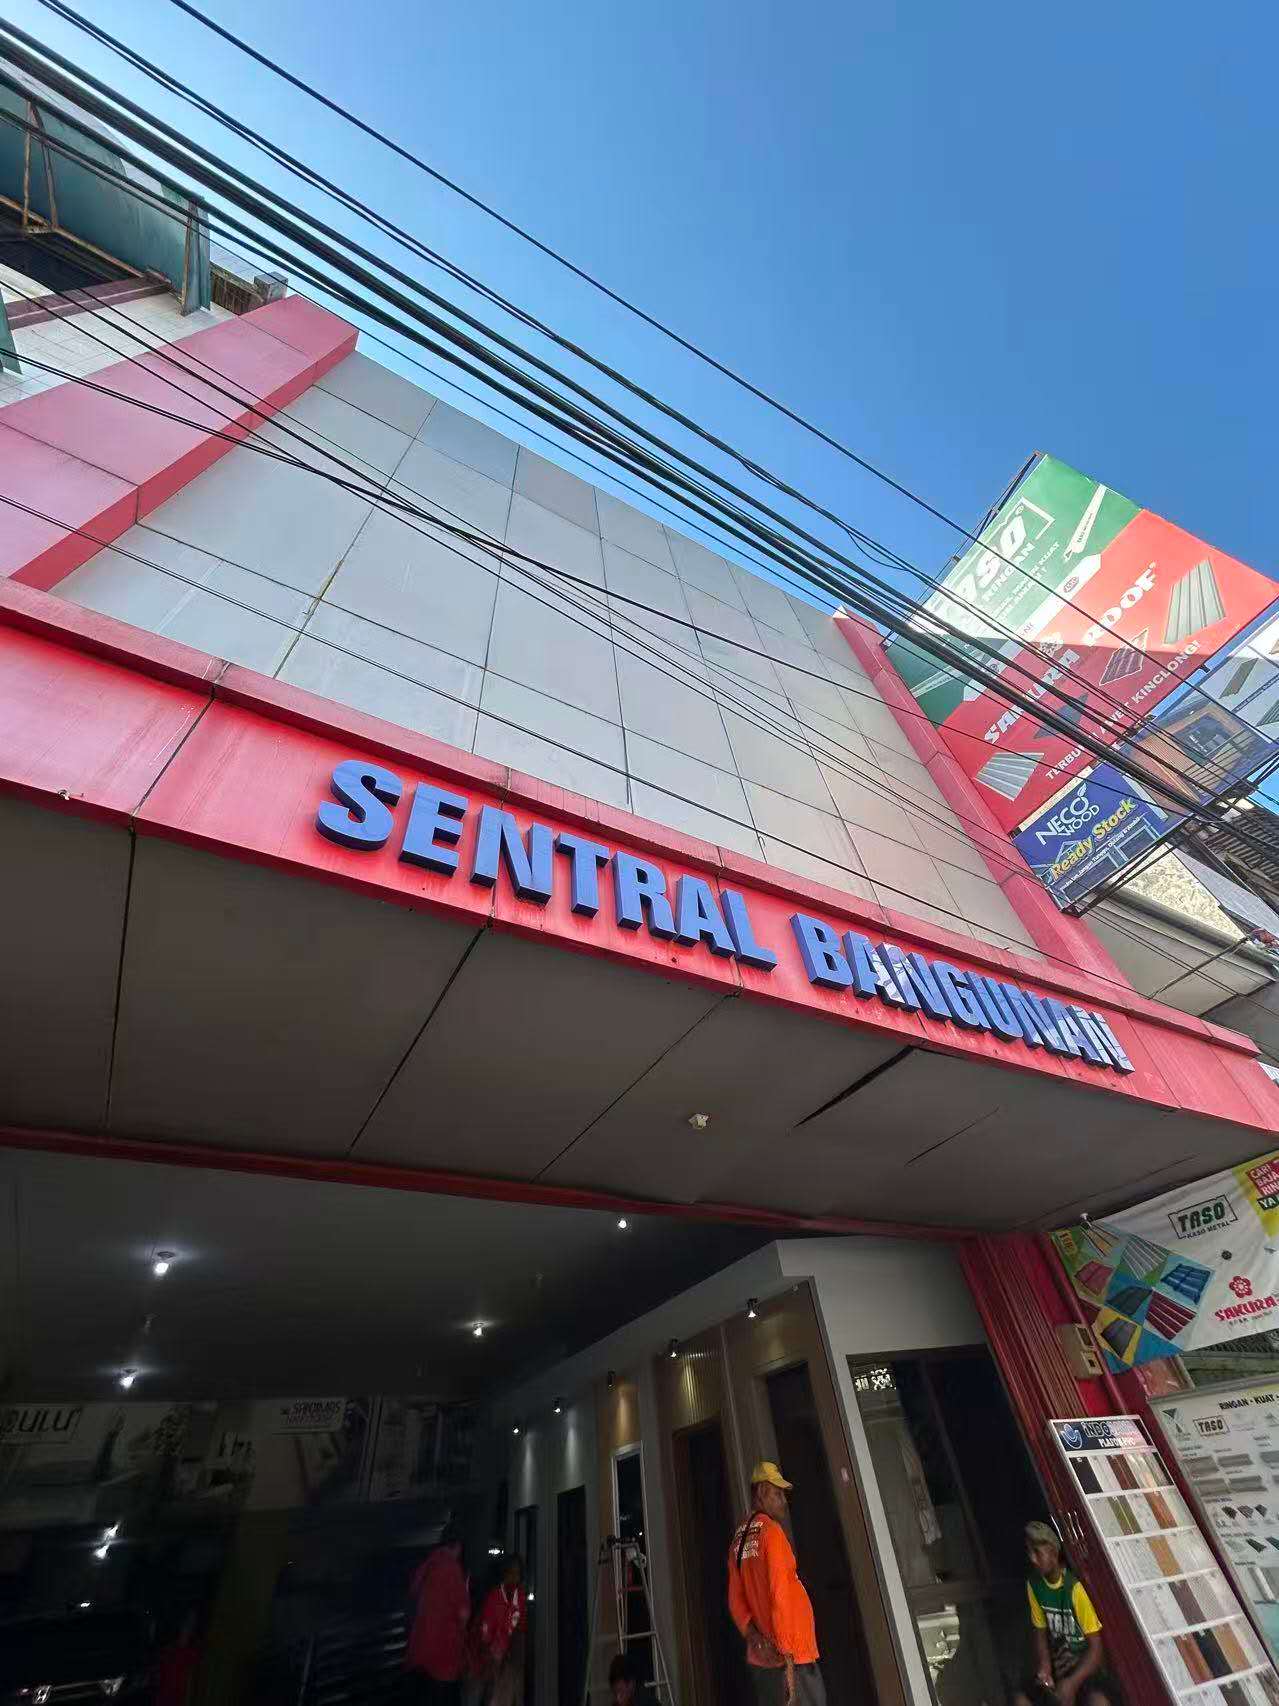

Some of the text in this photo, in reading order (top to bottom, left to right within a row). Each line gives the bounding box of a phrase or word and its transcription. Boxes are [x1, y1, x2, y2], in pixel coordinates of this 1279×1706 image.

[1132, 639, 1201, 707] KINCLONG!
[1035, 796, 1089, 845] NECO
[1058, 804, 1100, 836] WOOD
[1051, 836, 1094, 881] Ready
[1092, 799, 1138, 839] Stock
[315, 759, 1136, 1076] SENTRAL BANGUNAN
[1250, 1163, 1272, 1179] CARI
[1256, 1170, 1279, 1186] BAJA
[1178, 1201, 1226, 1233] TASO
[1215, 1296, 1277, 1320] SAKURA
[1218, 1398, 1250, 1410] RINGAN
[1253, 1394, 1275, 1404] KUAT
[1198, 1419, 1224, 1433] TASO
